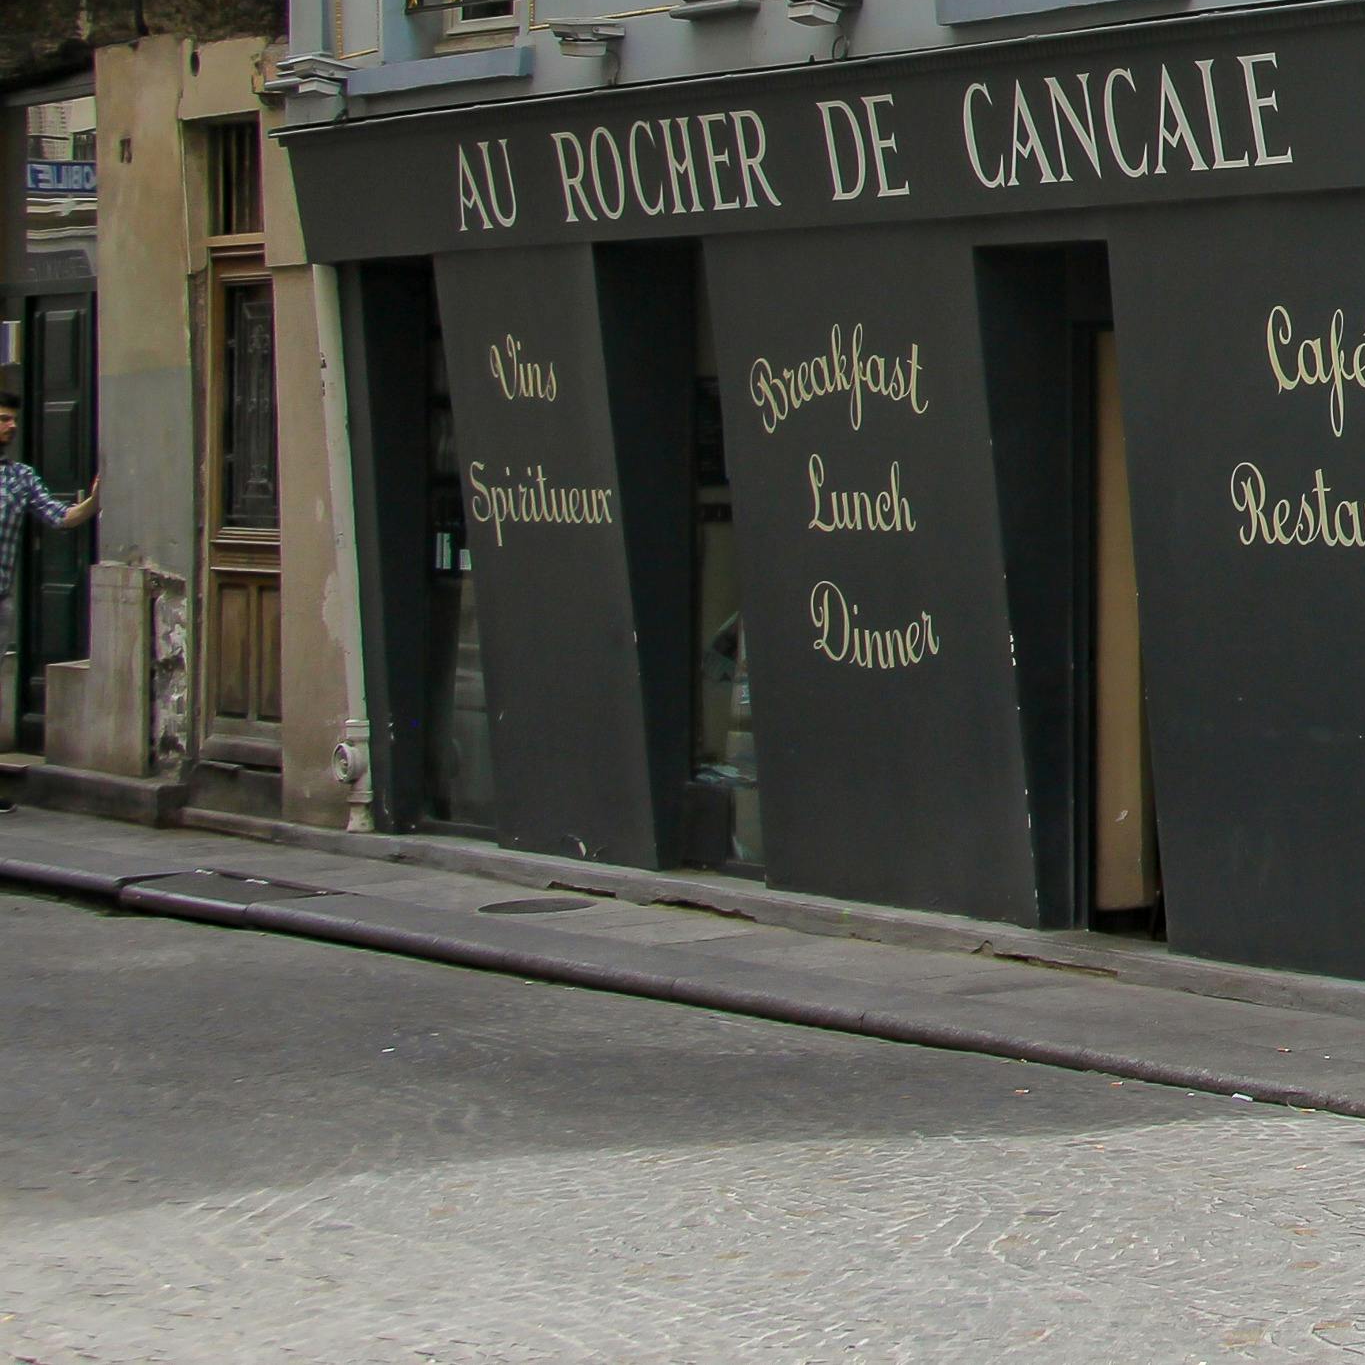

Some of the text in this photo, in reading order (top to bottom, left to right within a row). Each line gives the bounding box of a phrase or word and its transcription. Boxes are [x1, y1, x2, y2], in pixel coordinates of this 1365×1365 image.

[457, 52, 1292, 232] AU ROCHER DE CANCALE
[489, 334, 558, 402] Vins
[750, 322, 928, 434] Breakfast
[469, 460, 613, 547] Spiritueux
[808, 453, 916, 533] Lunch
[810, 580, 940, 669] Dinner
